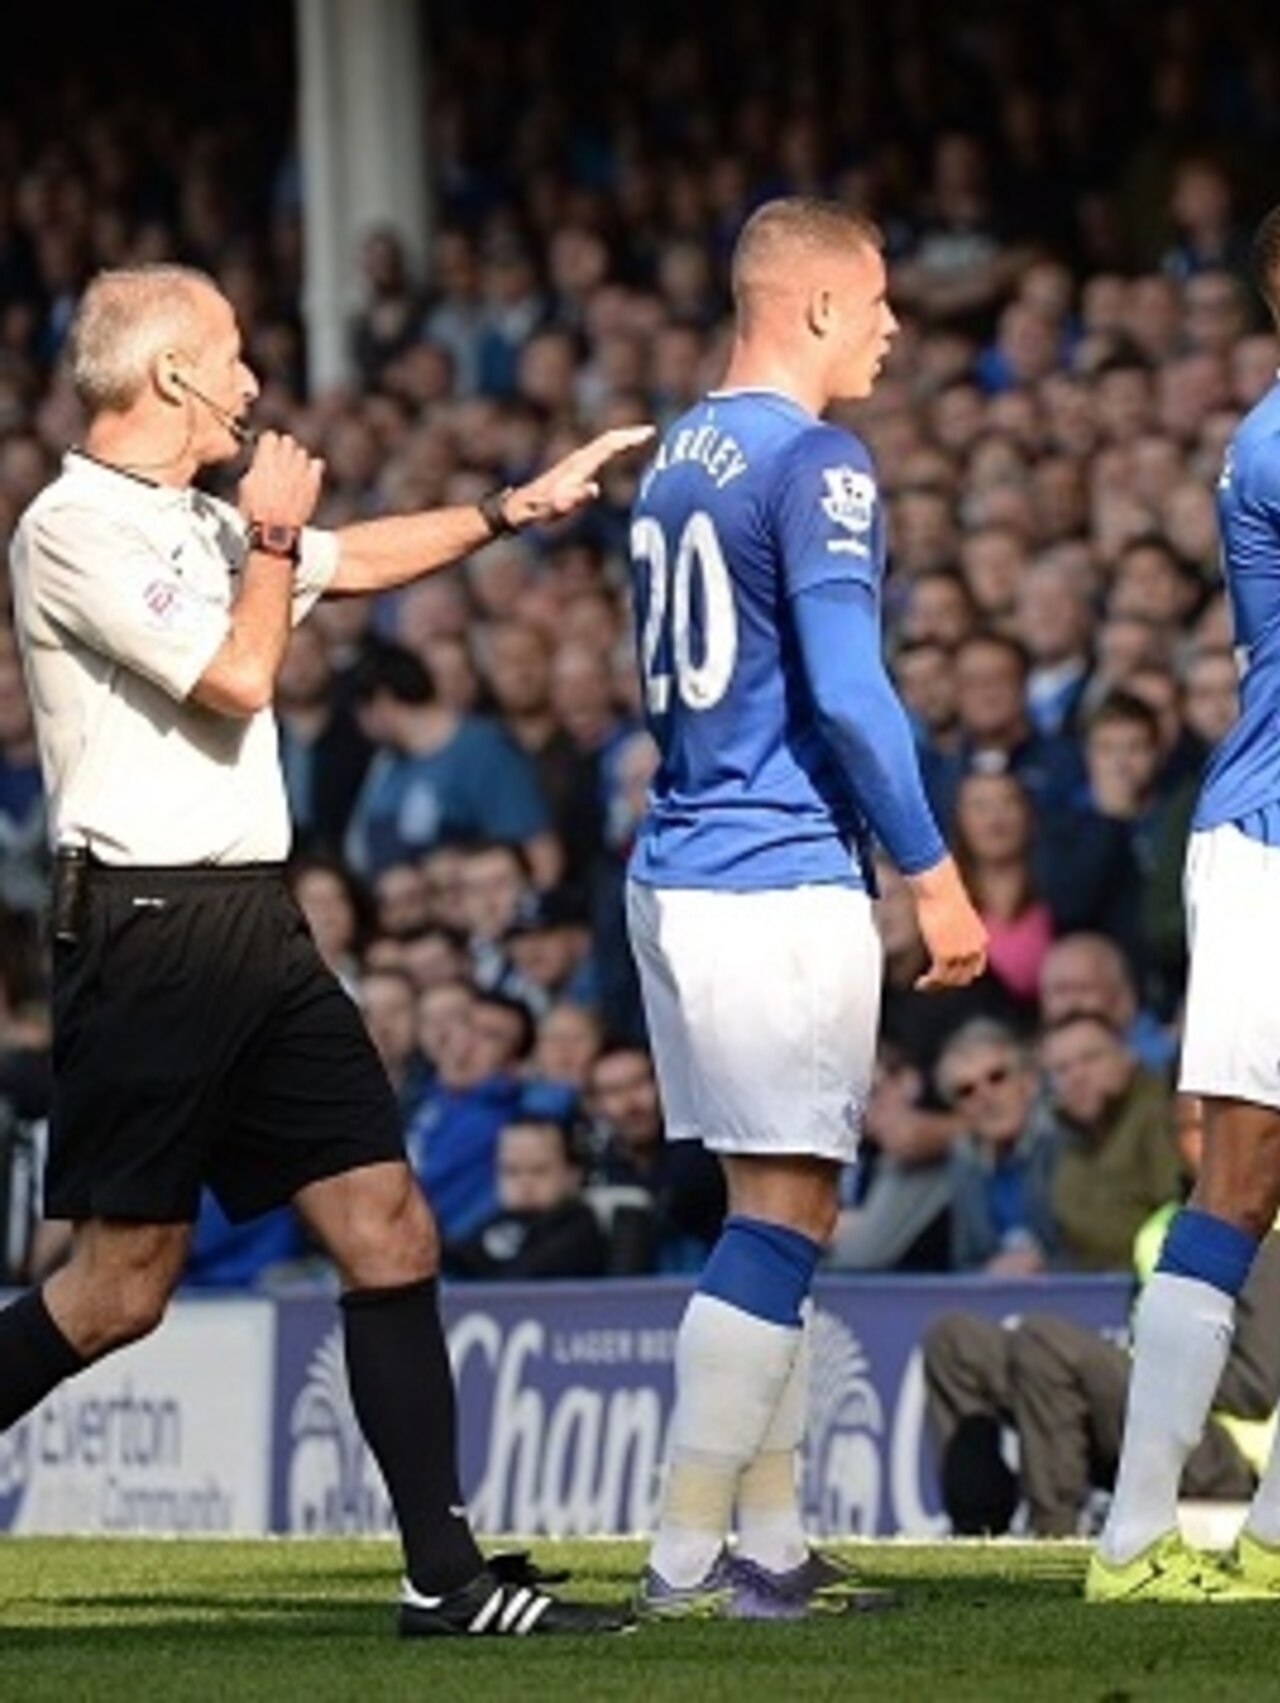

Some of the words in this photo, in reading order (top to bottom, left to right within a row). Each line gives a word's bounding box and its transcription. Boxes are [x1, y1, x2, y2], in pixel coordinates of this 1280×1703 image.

[630, 511, 738, 714] 20
[450, 1313, 664, 1534] Chan
[638, 1331, 677, 1364] BE
